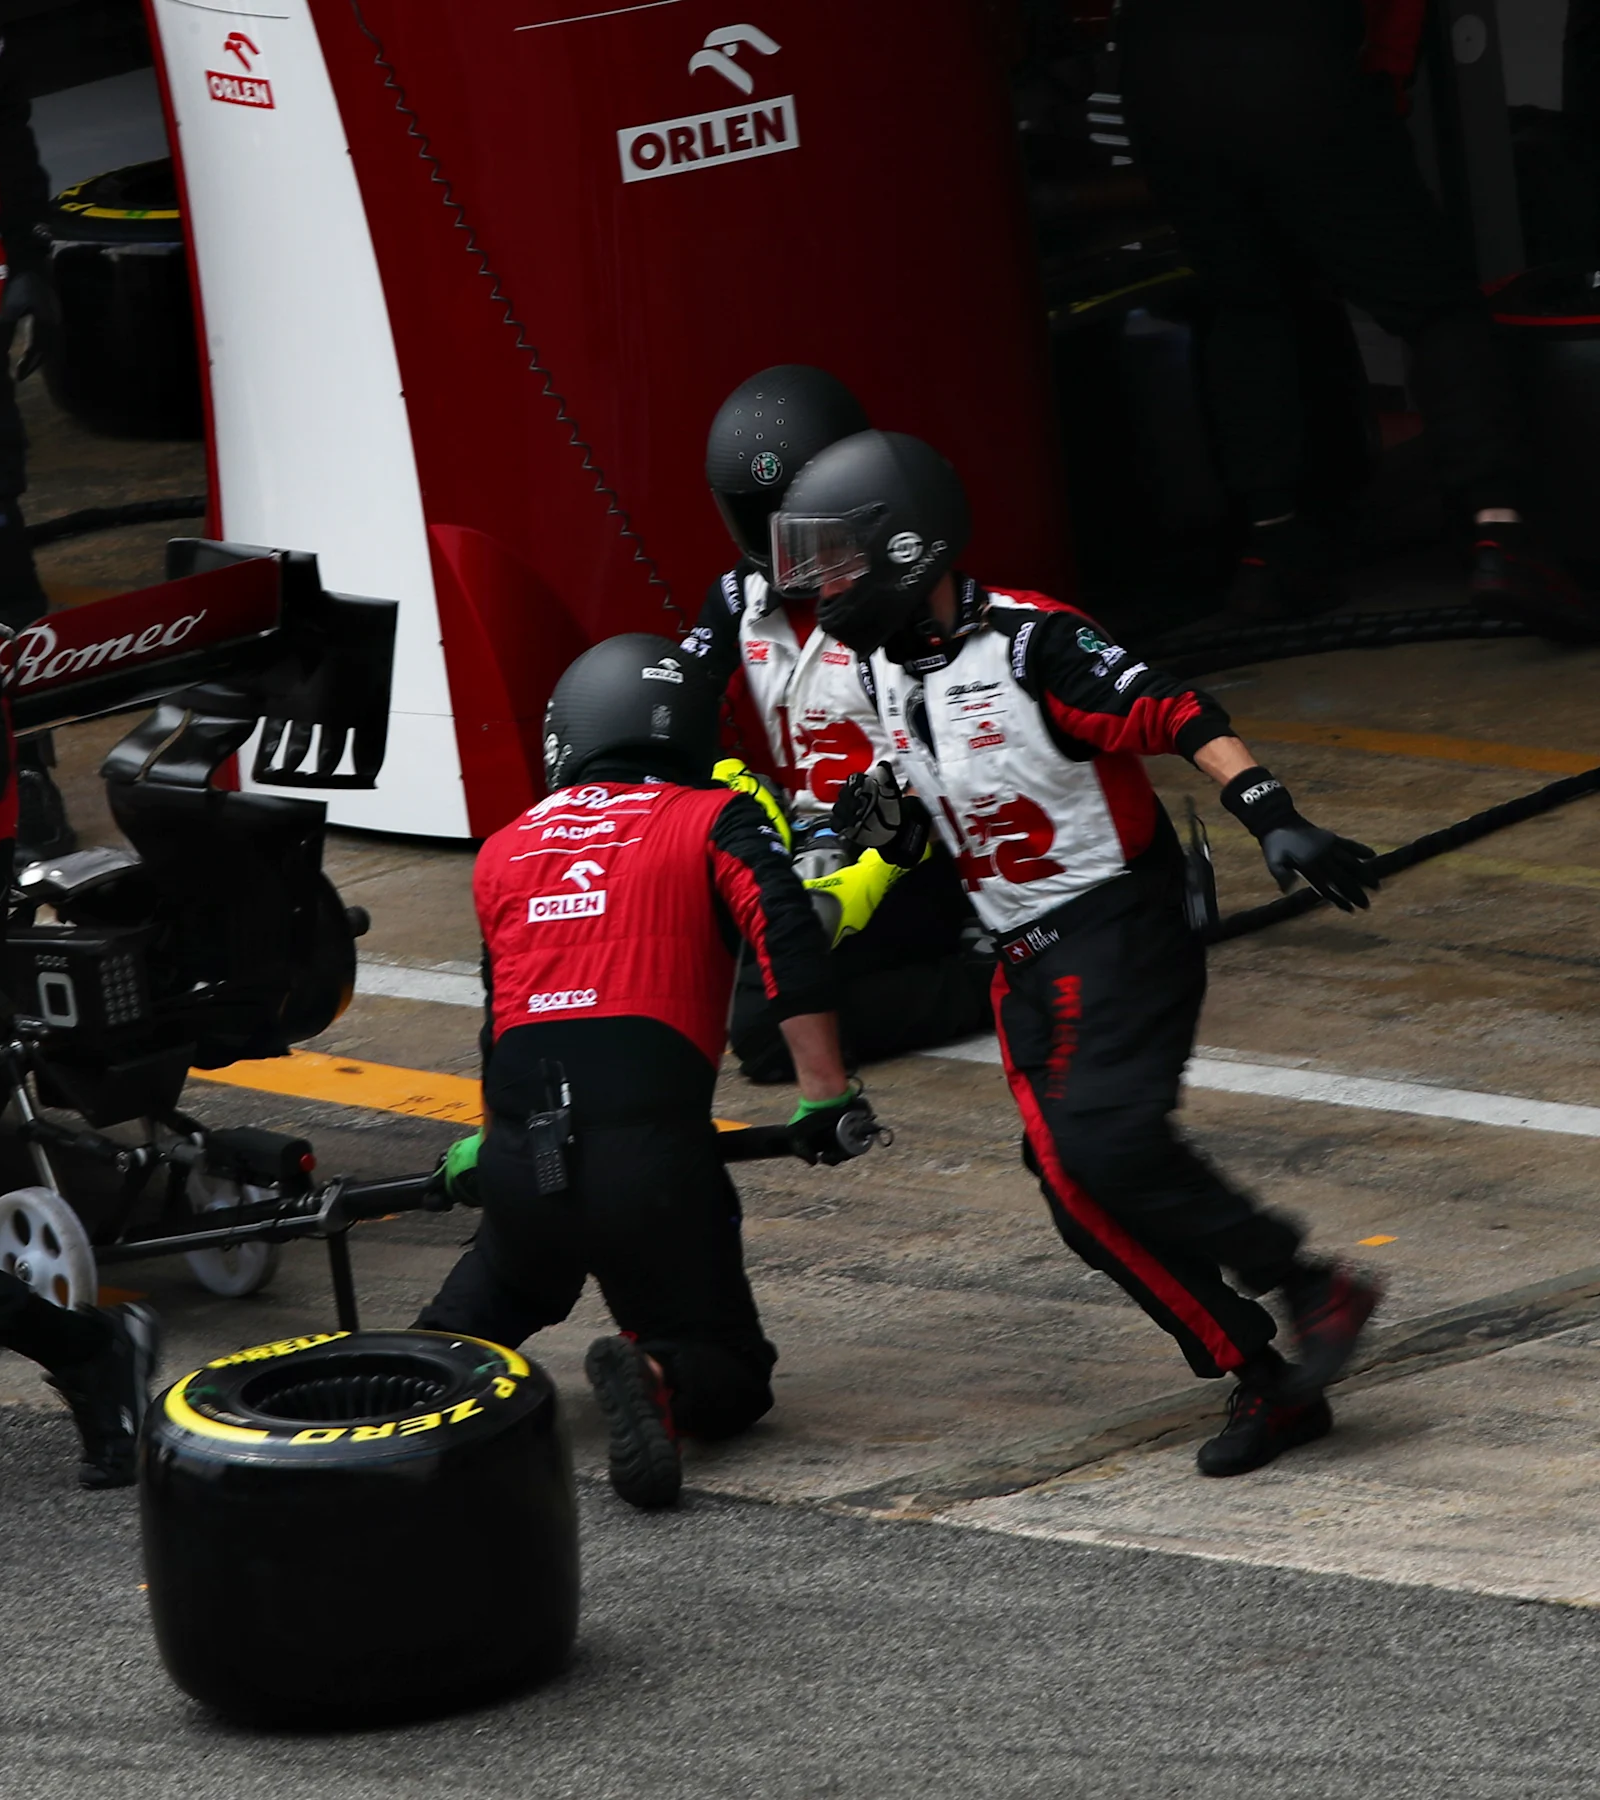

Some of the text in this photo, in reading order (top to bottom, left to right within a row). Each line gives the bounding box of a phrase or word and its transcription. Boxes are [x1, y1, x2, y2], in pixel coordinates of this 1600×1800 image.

[208, 75, 269, 105] ORLEN
[630, 106, 786, 170] ORLEN
[527, 786, 660, 821] Alfa Romeo
[540, 821, 617, 842] RACING
[534, 896, 599, 917] ORLEN
[527, 987, 597, 1014] sparco
[287, 1397, 486, 1447] ZERO
